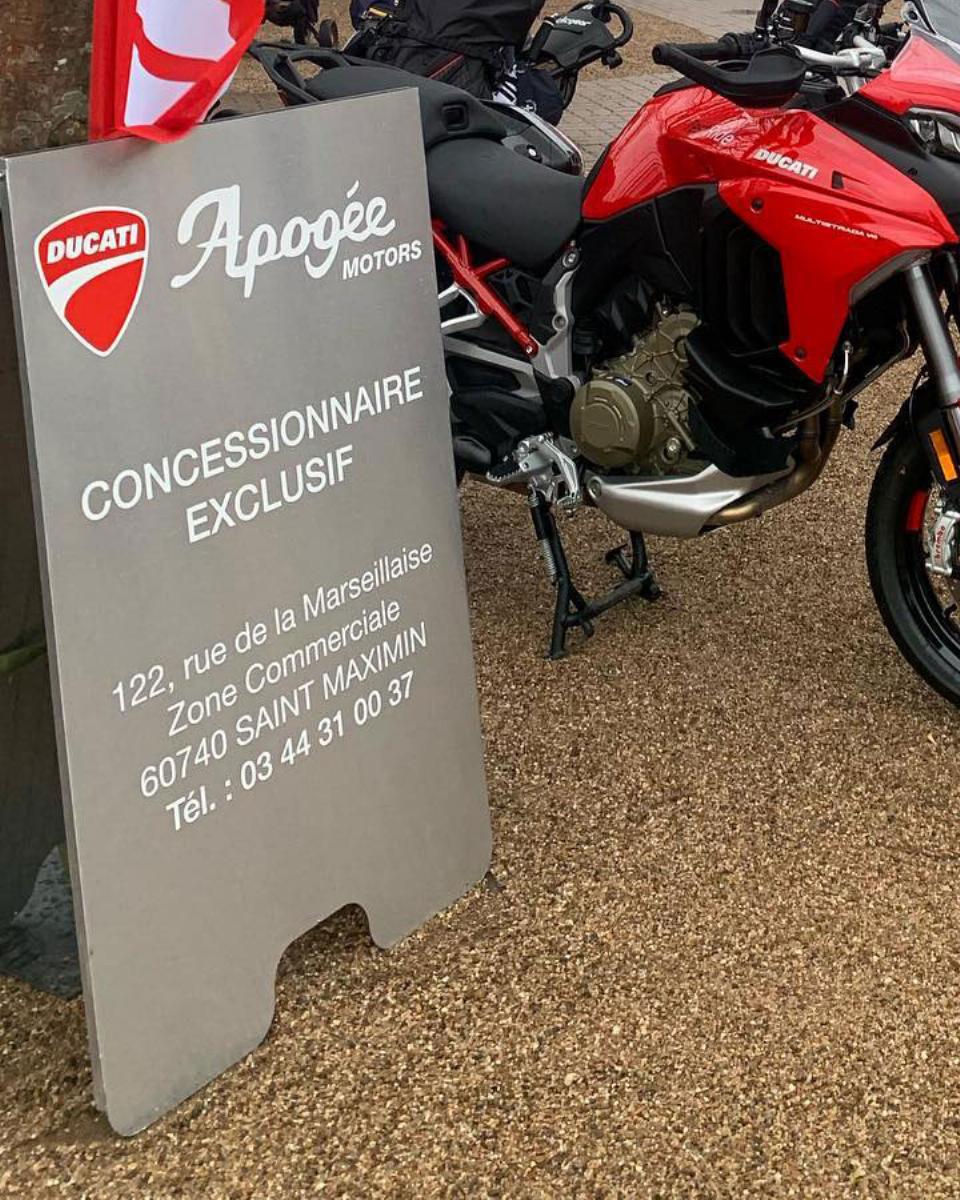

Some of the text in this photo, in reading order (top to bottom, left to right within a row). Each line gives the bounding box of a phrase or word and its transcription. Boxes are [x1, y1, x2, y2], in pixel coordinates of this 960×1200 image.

[753, 149, 819, 180] DUCATI
[47, 223, 139, 264] DUCATI
[170, 180, 396, 298] Apogée
[342, 240, 423, 280] MOTORS
[81, 366, 424, 521] CONCESSIONNAIRE
[186, 445, 354, 543] EXCLUSIF
[934, 525, 946, 559] brembo
[112, 542, 433, 712] 122, rue de la Marseillaise
[167, 600, 401, 736] Zone Commerciale
[140, 622, 427, 798] 60740 SAINT MAXIMIN
[166, 671, 414, 831] Tél. : 03 44 31 00 37
